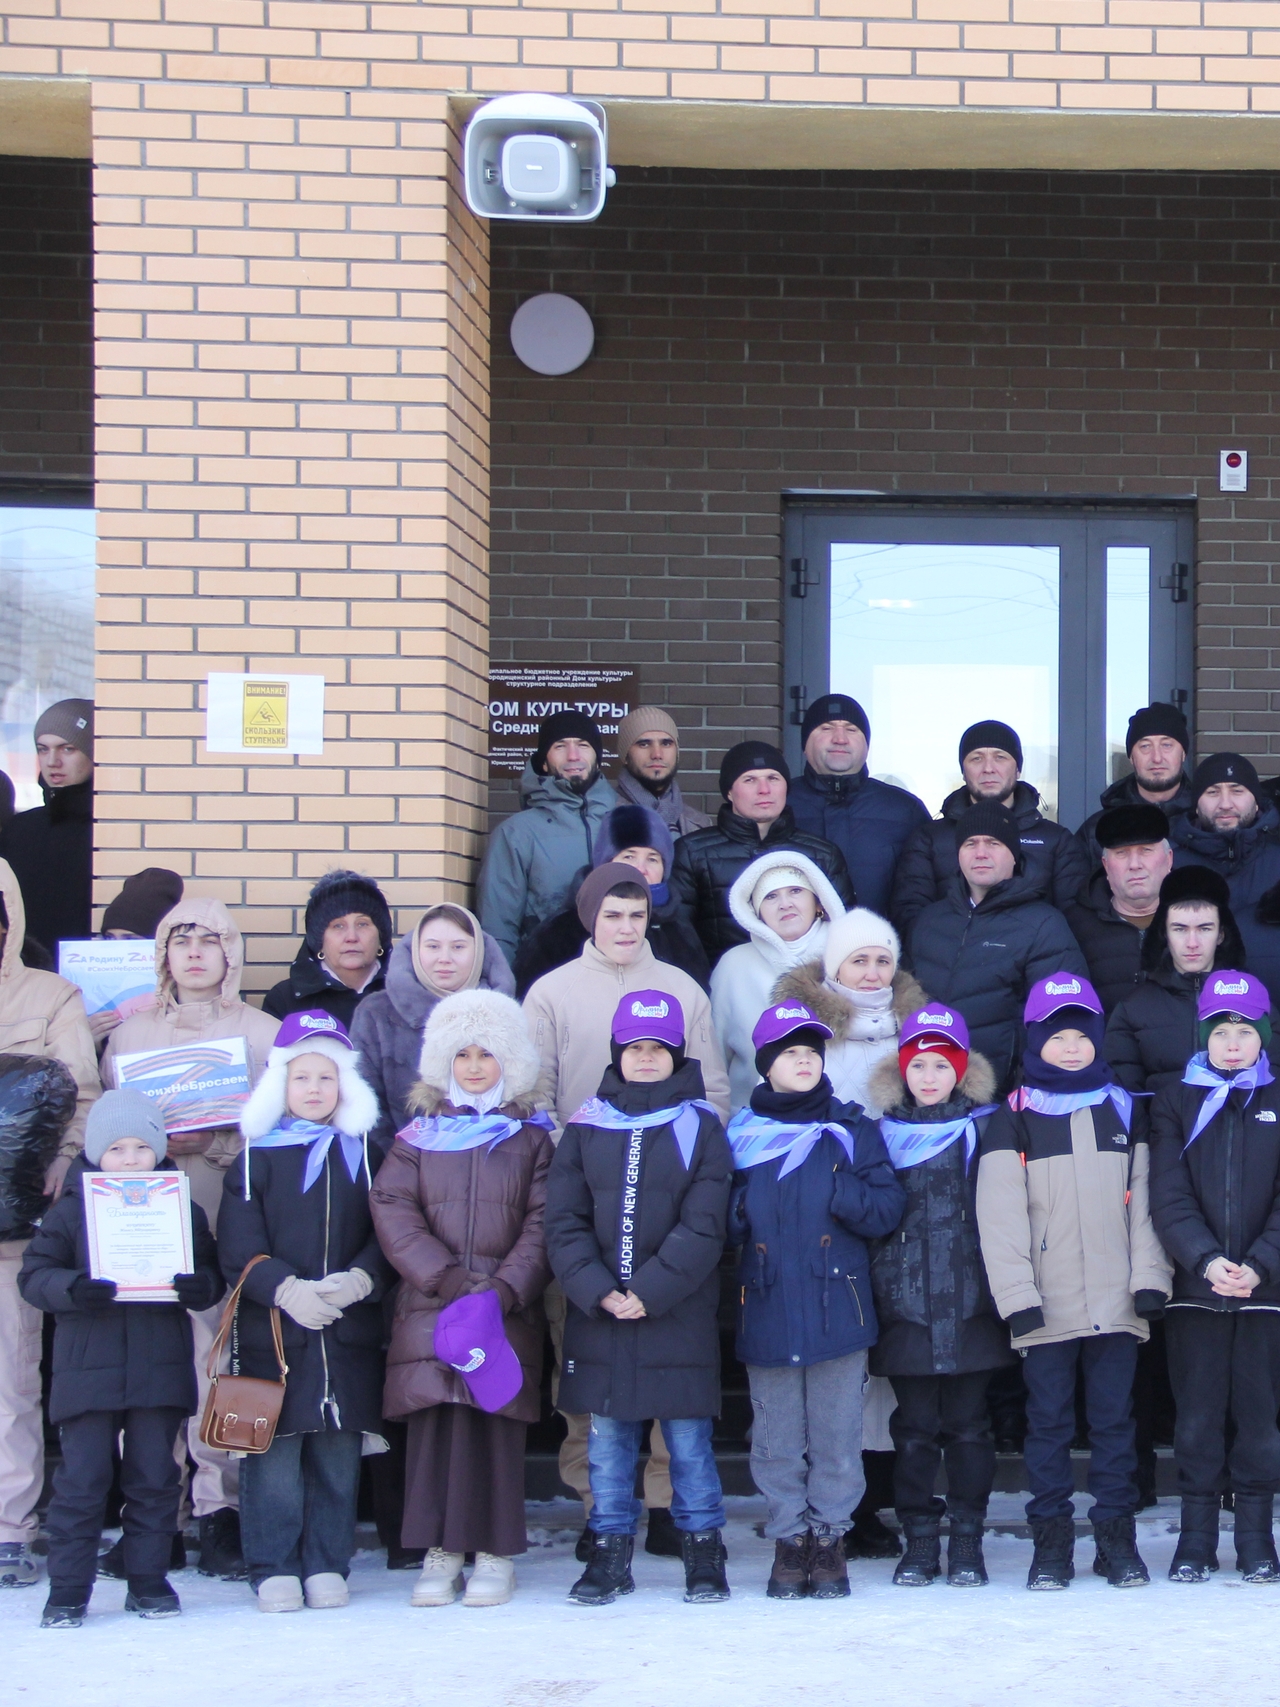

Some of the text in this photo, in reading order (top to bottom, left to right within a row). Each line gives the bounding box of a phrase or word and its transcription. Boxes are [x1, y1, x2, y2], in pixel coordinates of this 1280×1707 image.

[247, 686, 286, 695] ВНИМАНИЕ!
[489, 701, 519, 717] ОМ
[245, 727, 286, 735] СКОЛЬЗКИЕ
[245, 736, 286, 744] СТУПЕНЬКИ
[624, 1186, 637, 1214] NEW
[622, 1216, 635, 1233] OF
[621, 1235, 634, 1280] LEADER
